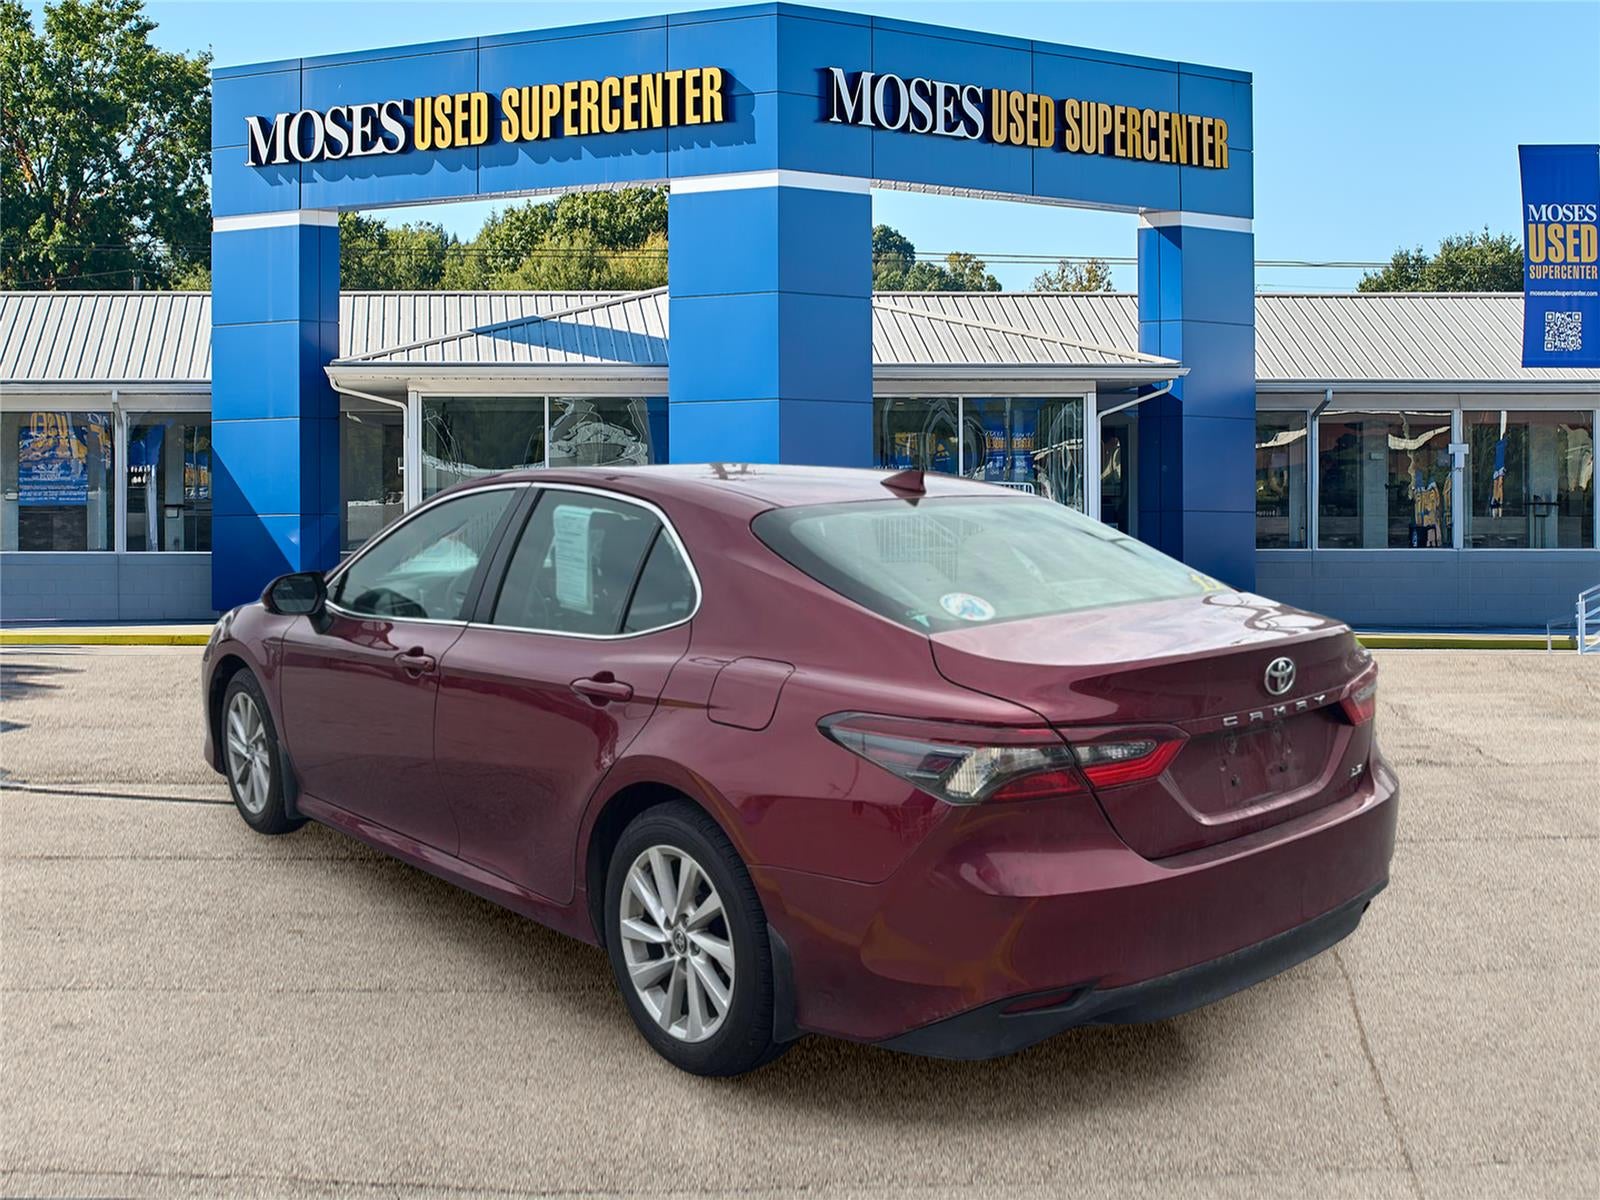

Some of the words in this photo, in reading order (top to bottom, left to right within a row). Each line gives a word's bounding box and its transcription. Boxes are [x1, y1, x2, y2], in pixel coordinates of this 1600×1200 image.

[244, 99, 407, 167] MOSES
[413, 92, 489, 152] USED
[501, 66, 724, 143] SUPERCENTER
[829, 66, 984, 140] MOSES
[991, 88, 1056, 149] USED
[1065, 98, 1229, 170] SUPERCENTER
[1528, 203, 1597, 222] MOSES
[1528, 223, 1598, 264] USED
[1529, 264, 1598, 280] SUPERCENTER
[1223, 694, 1326, 727] CAMRY
